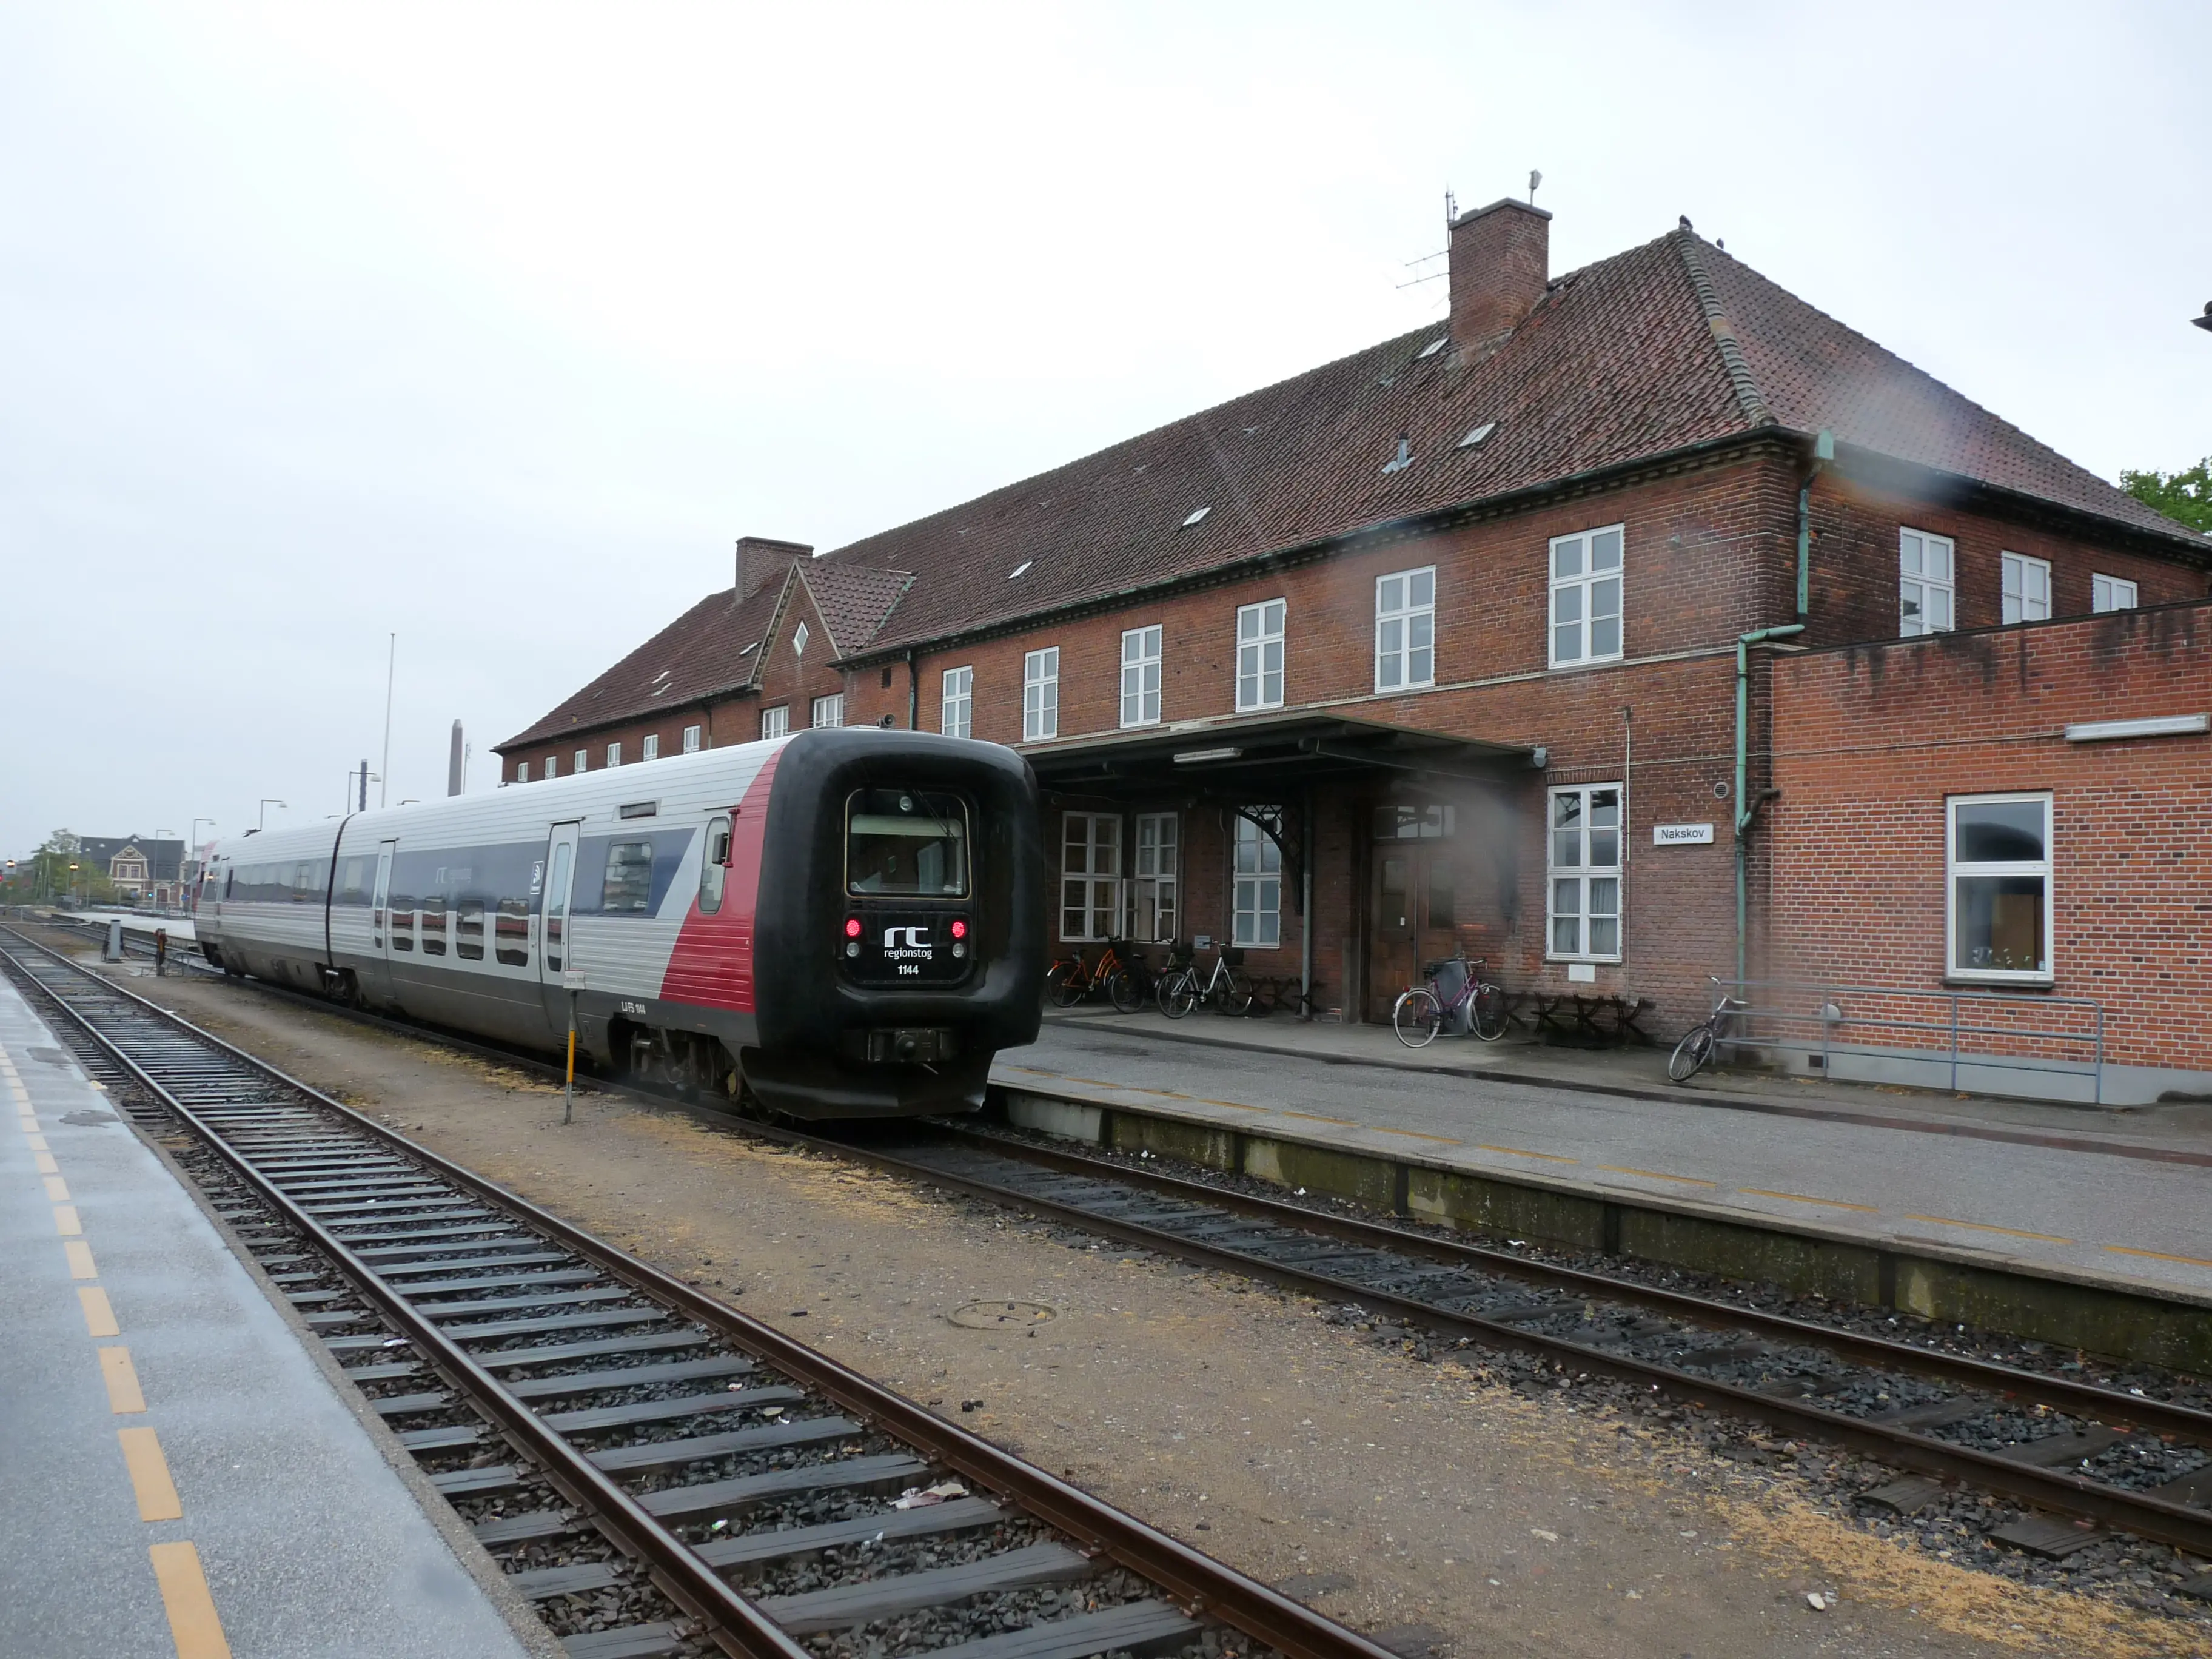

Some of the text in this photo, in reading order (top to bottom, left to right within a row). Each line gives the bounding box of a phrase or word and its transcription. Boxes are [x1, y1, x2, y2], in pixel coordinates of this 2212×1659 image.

[1661, 828, 1704, 839] Nakskov
[884, 947, 932, 960] regionstog
[897, 965, 919, 974] 1144
